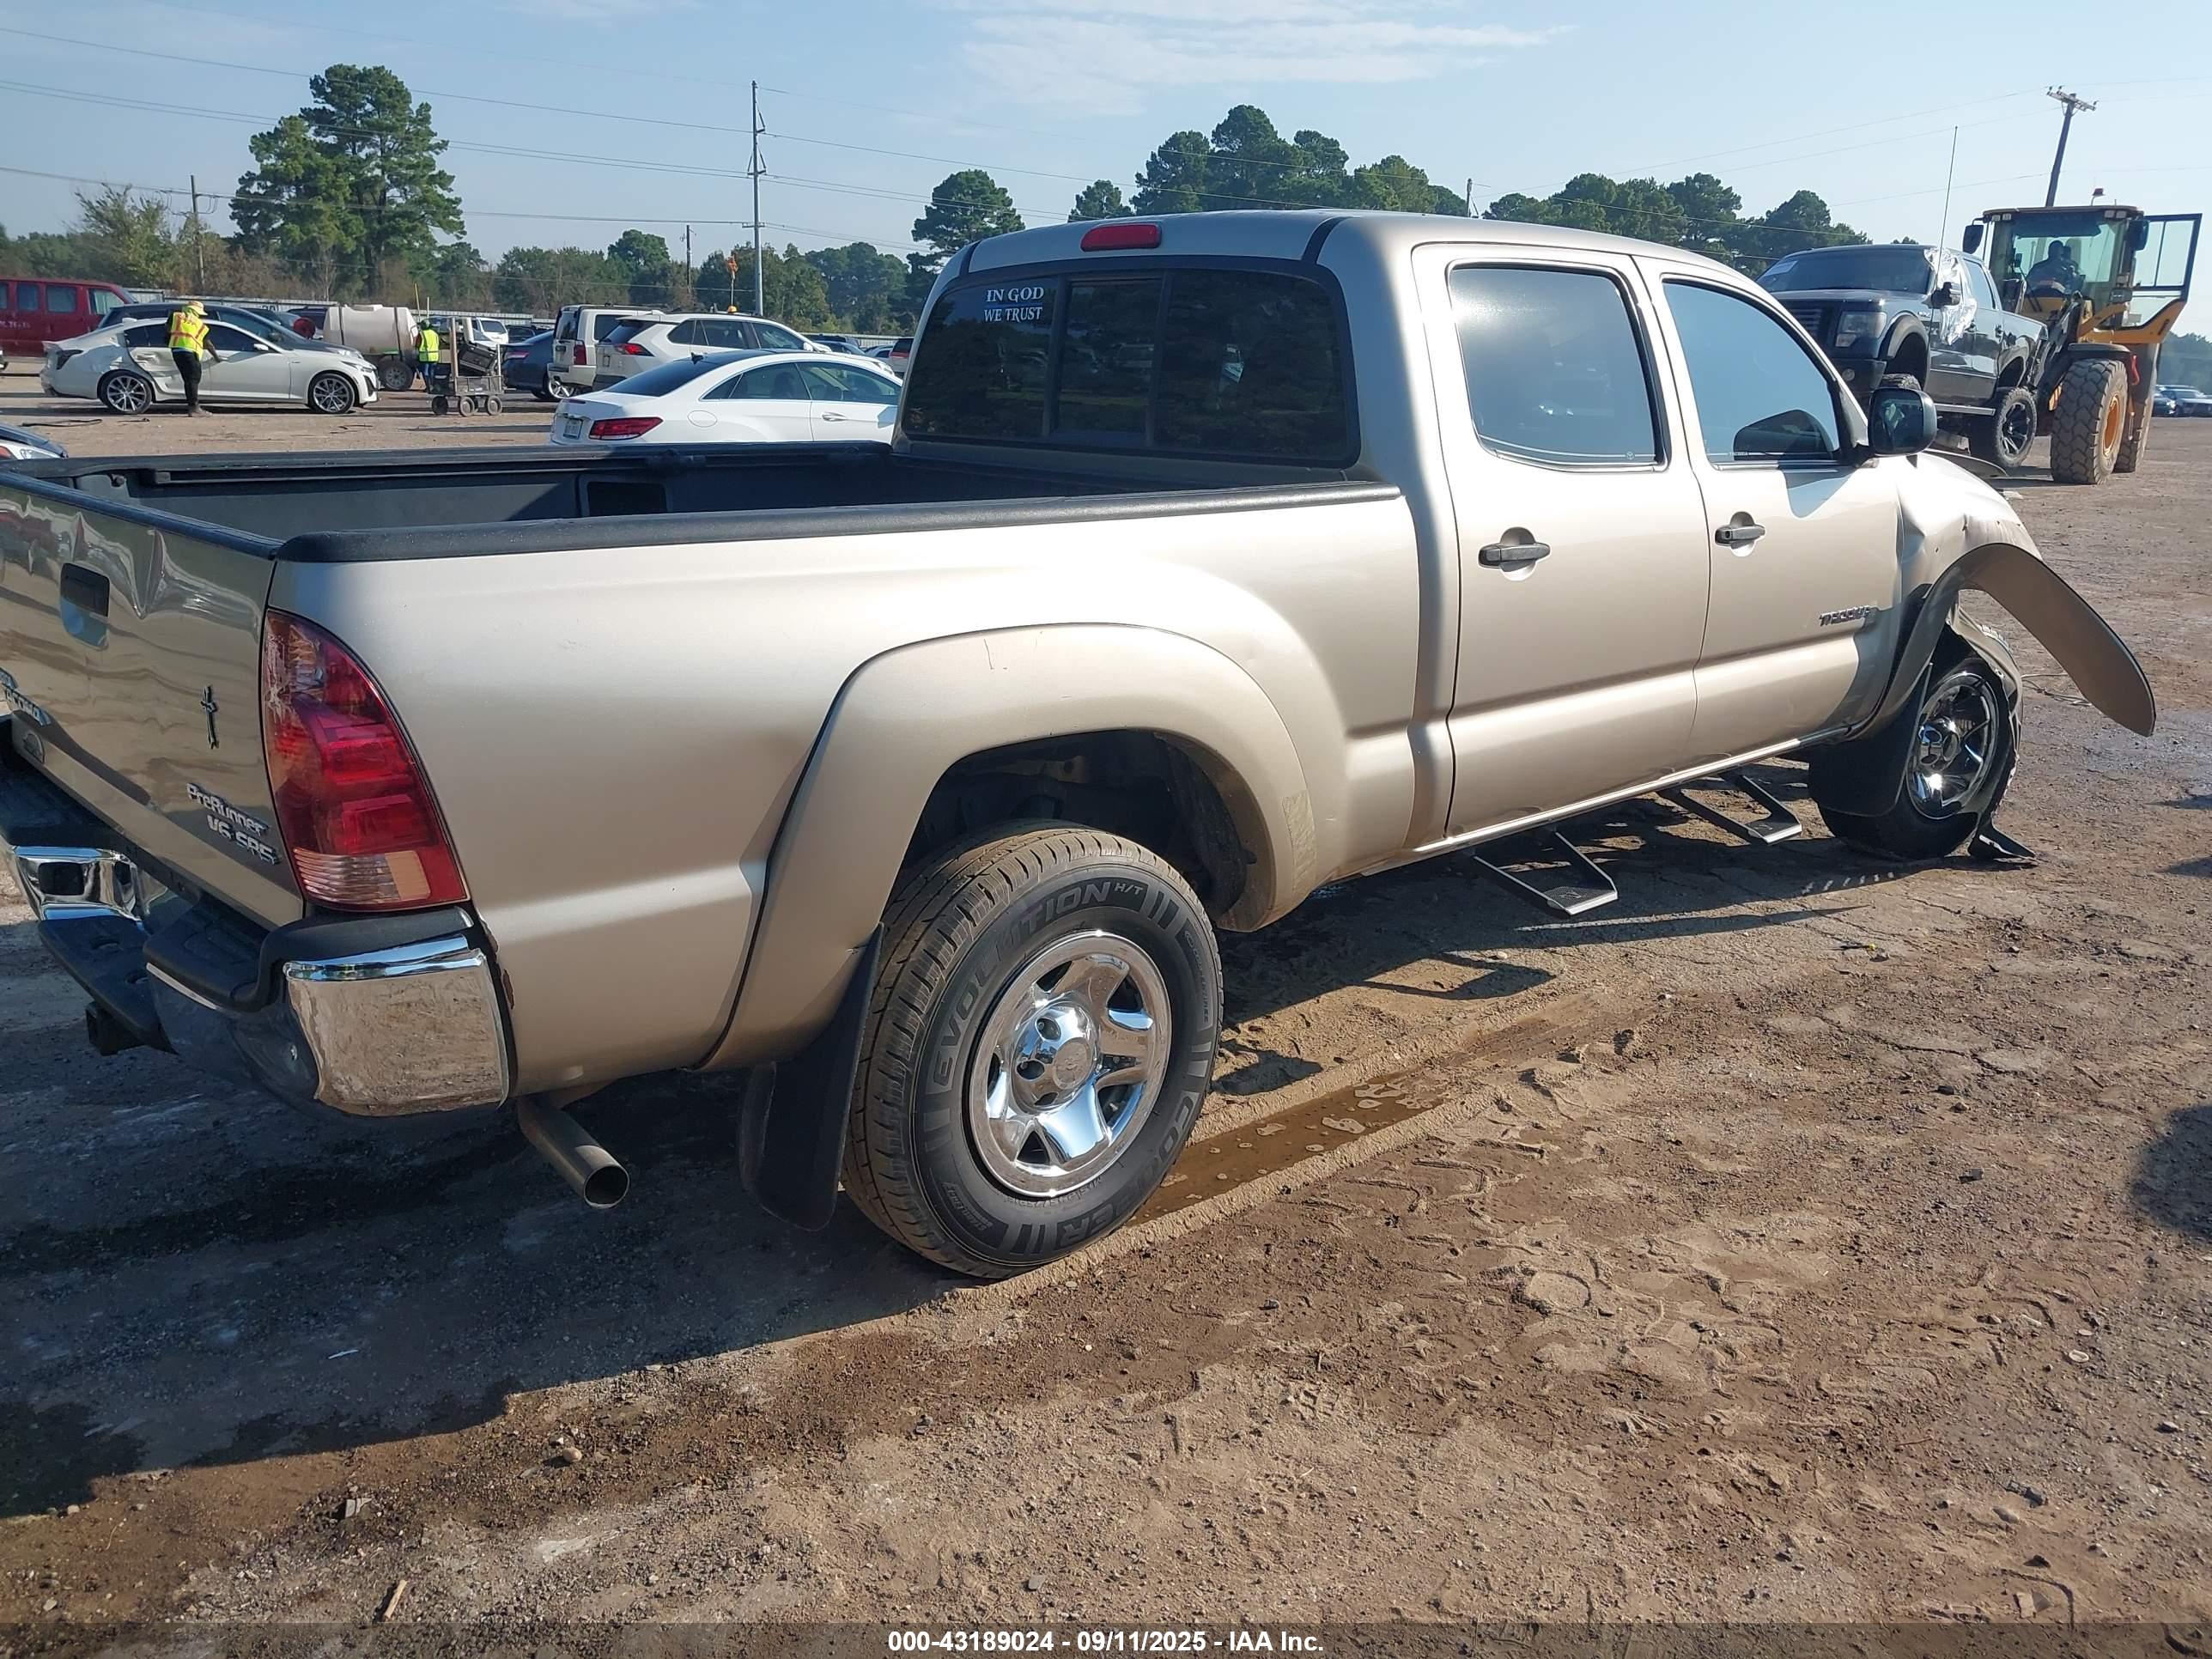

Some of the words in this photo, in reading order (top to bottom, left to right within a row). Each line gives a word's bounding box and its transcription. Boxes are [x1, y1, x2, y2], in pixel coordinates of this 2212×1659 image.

[986, 289, 1005, 302] IN
[1007, 287, 1044, 303] GOD
[984, 308, 1002, 322] WE
[1006, 307, 1043, 323] TRUST
[186, 782, 266, 837] PreRunner
[207, 814, 232, 840] V6
[234, 830, 276, 866] SR5
[1114, 882, 1144, 896] H/T
[1060, 1096, 1194, 1242] COER
